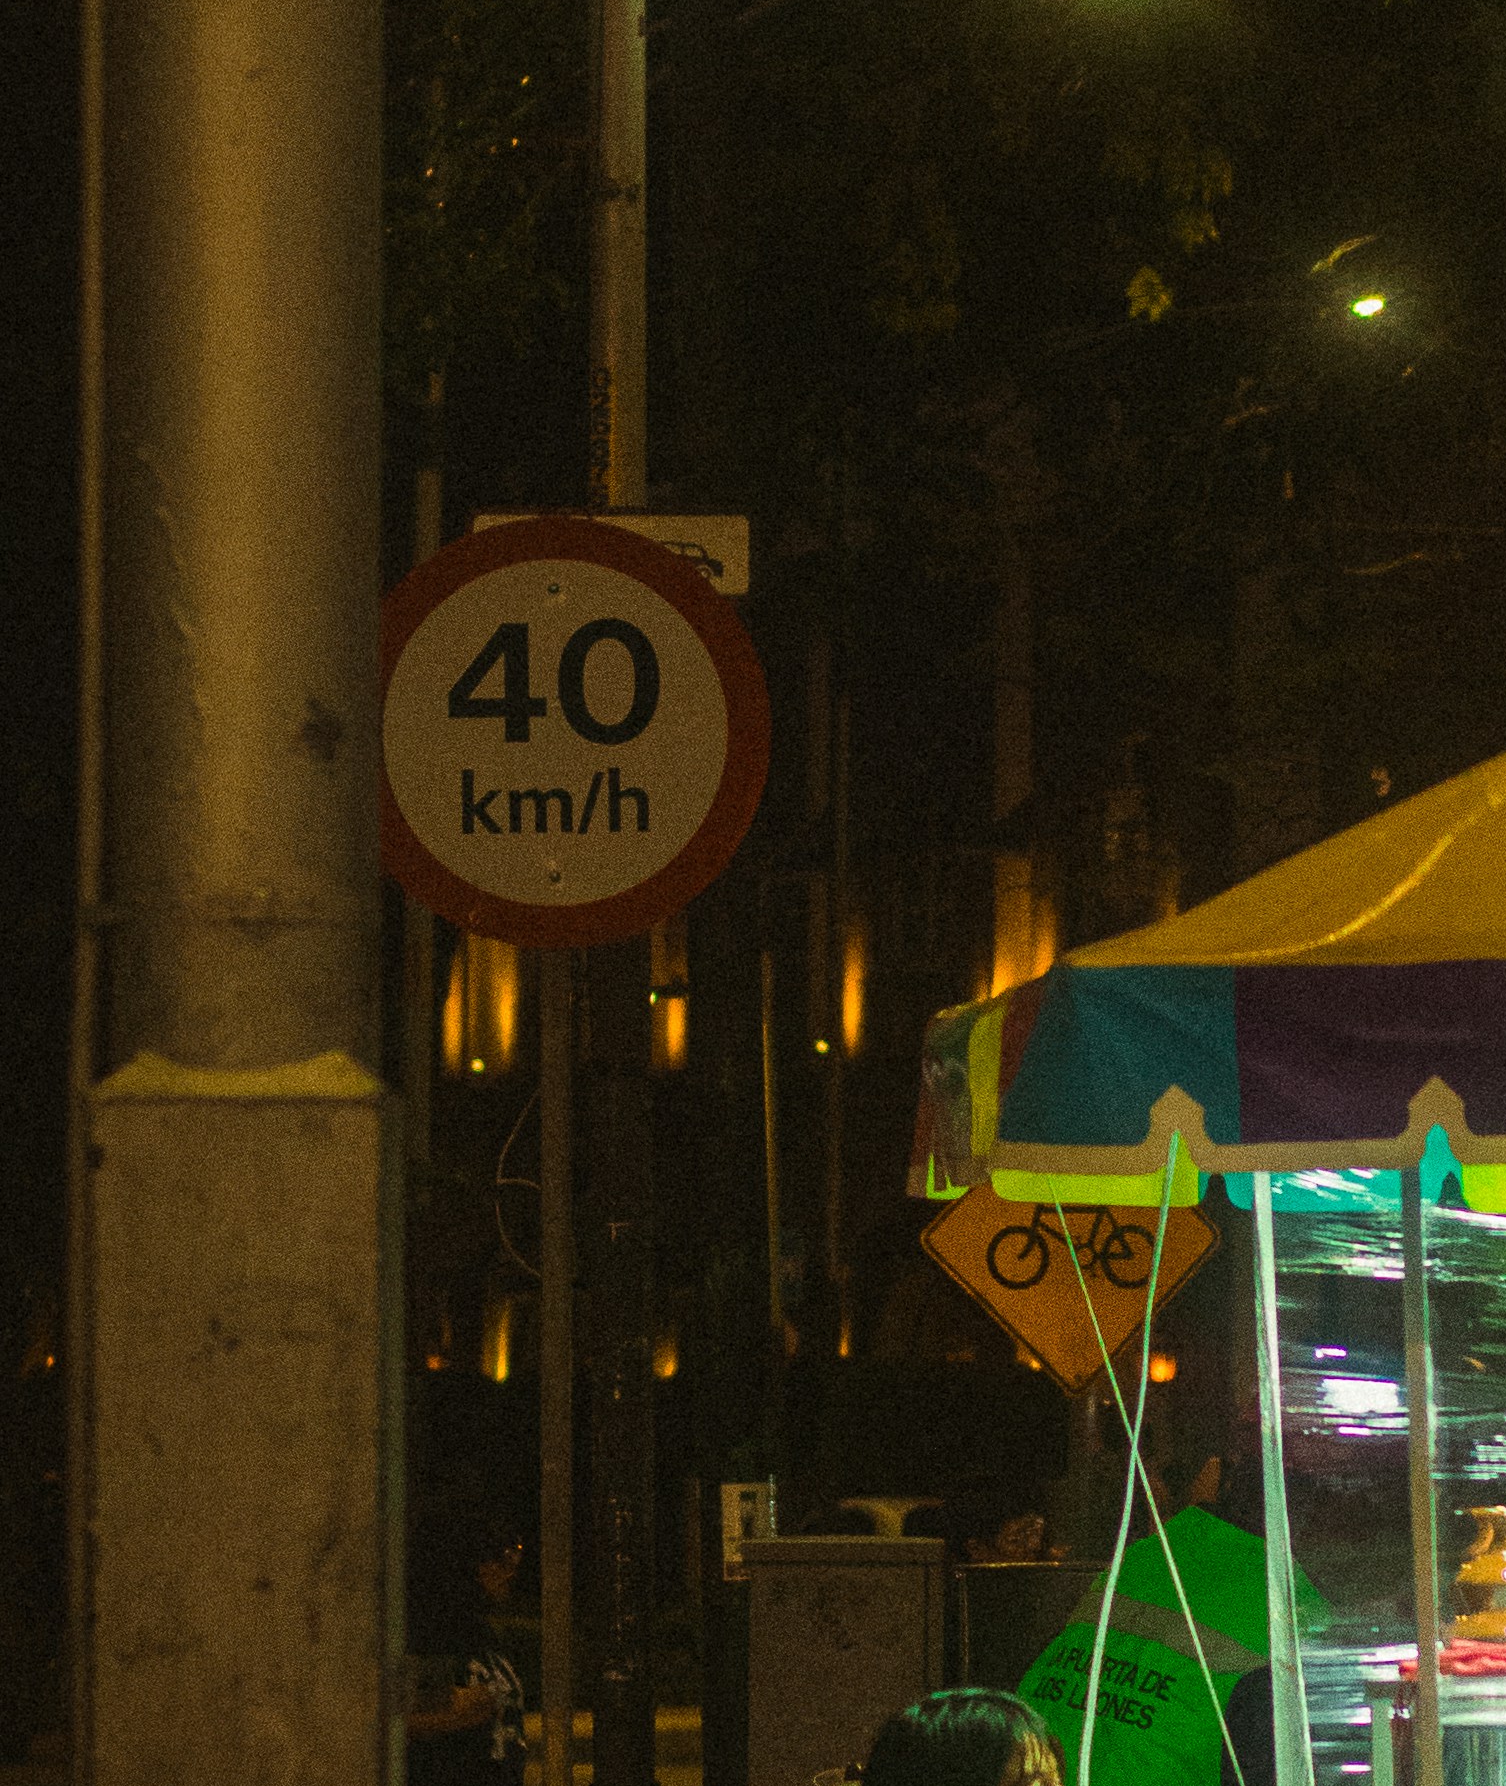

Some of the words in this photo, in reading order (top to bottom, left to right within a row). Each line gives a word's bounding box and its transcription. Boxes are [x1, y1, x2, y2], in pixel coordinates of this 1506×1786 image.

[448, 618, 660, 745] 40
[461, 769, 650, 835] km/h
[1062, 1647, 1139, 1689] PURTA
[1138, 1668, 1177, 1702] DE
